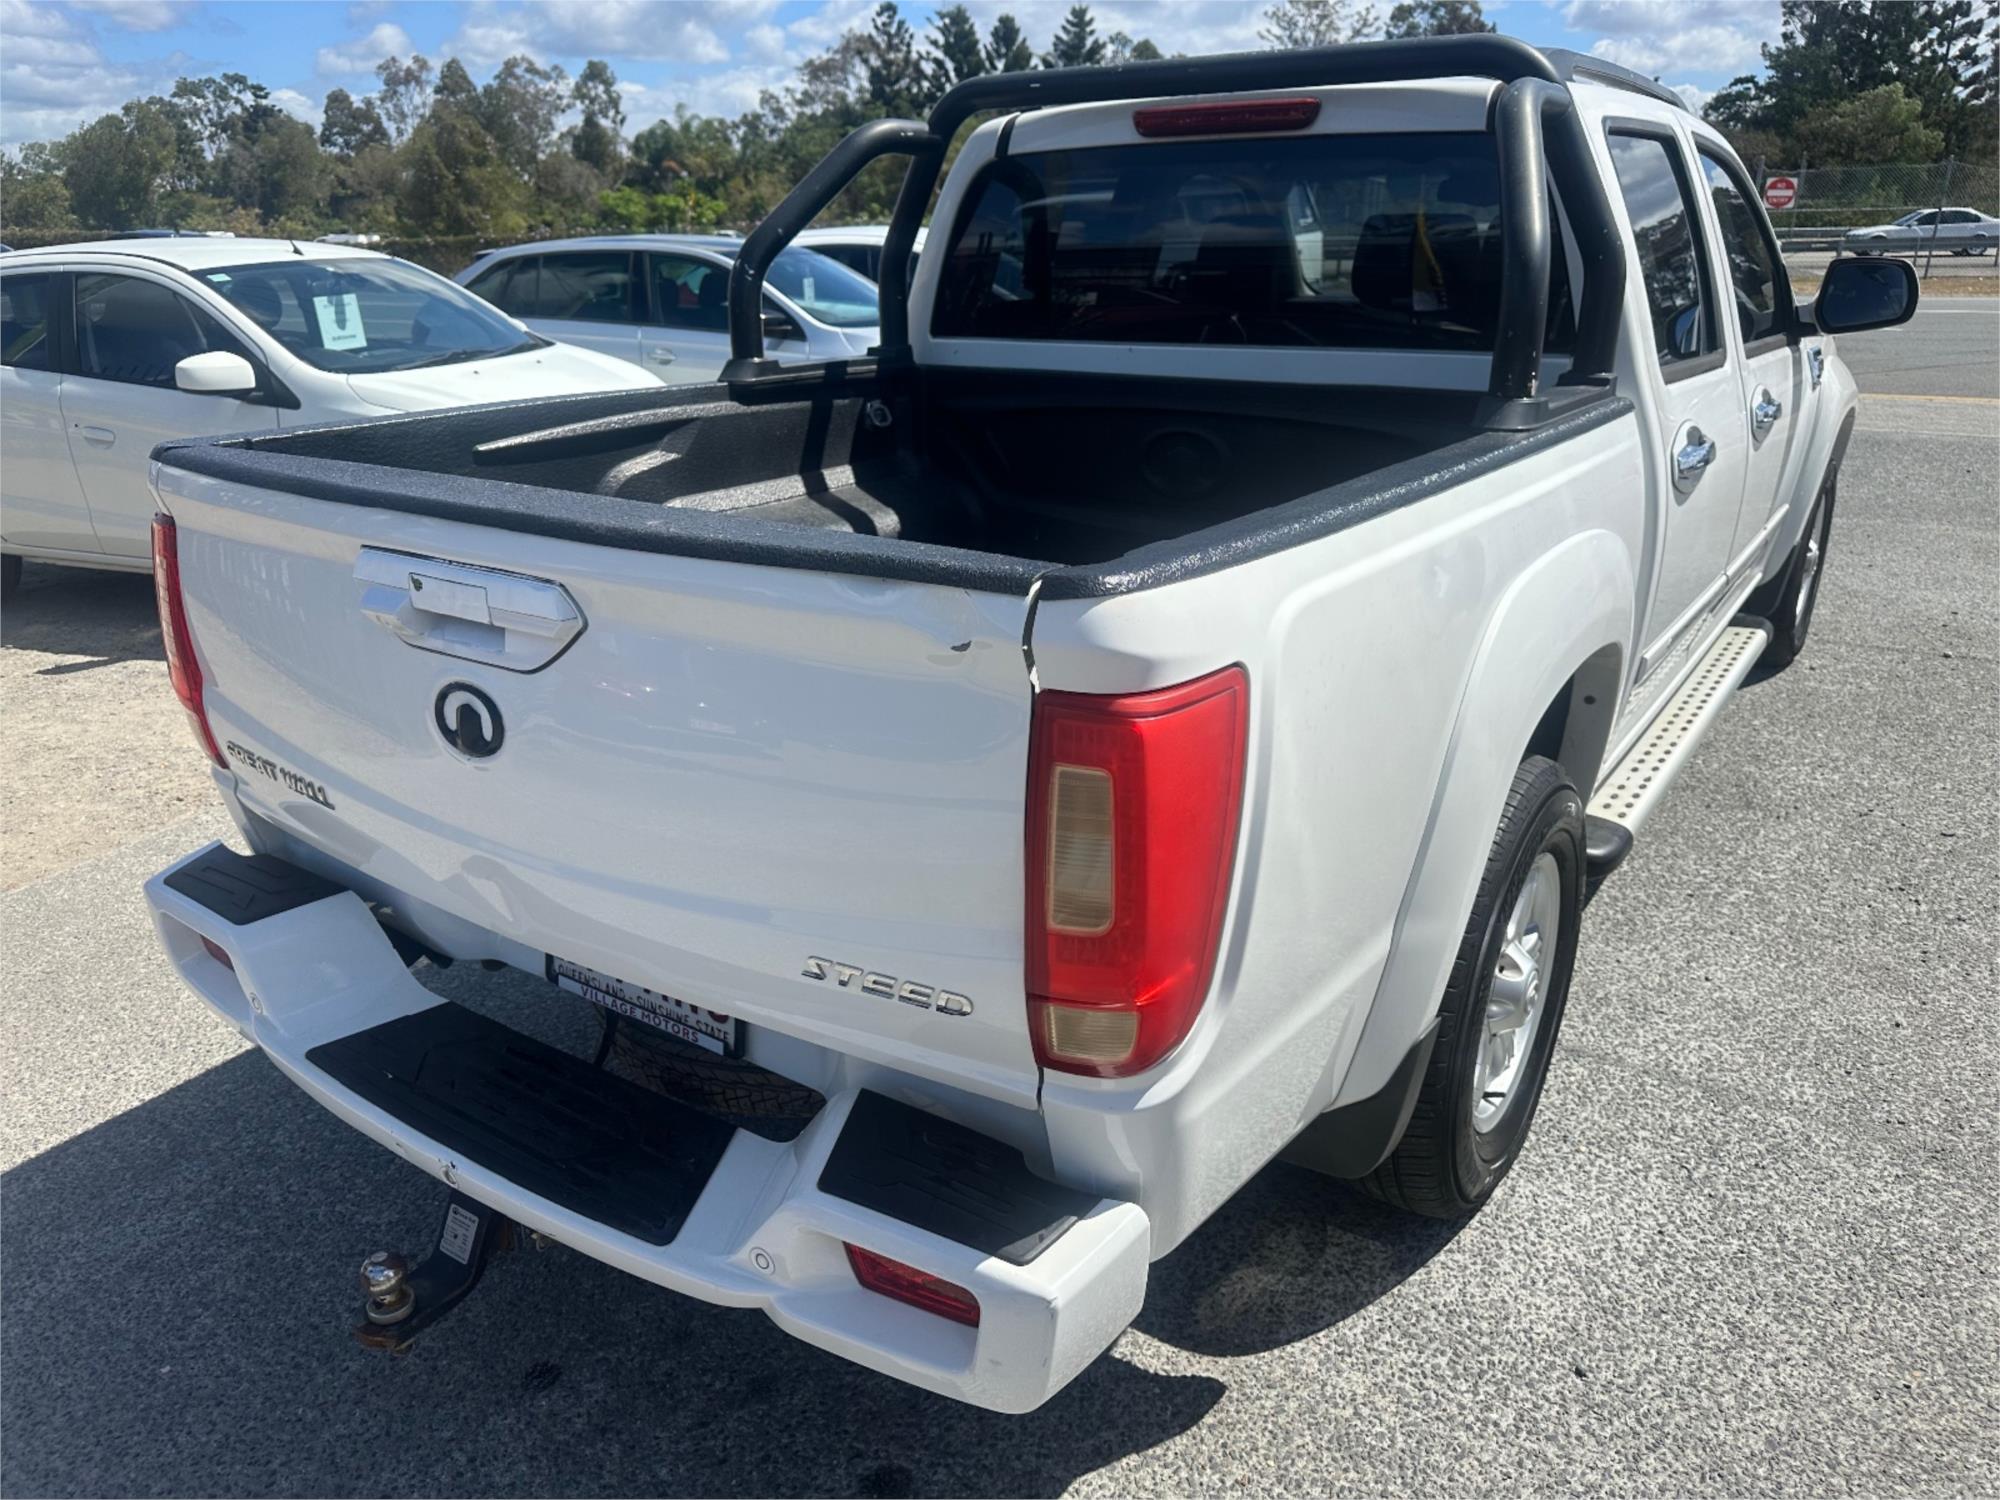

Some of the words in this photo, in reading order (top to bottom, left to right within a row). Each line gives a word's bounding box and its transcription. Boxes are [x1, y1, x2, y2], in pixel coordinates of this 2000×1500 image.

[557, 963, 626, 1001] QUEENSLAND
[636, 994, 690, 1025] SUNSHINE
[695, 1019, 731, 1042] STATE
[580, 984, 638, 1018] VILLAGE
[640, 1010, 700, 1043] MOTORS
[801, 955, 975, 1017] STEED
